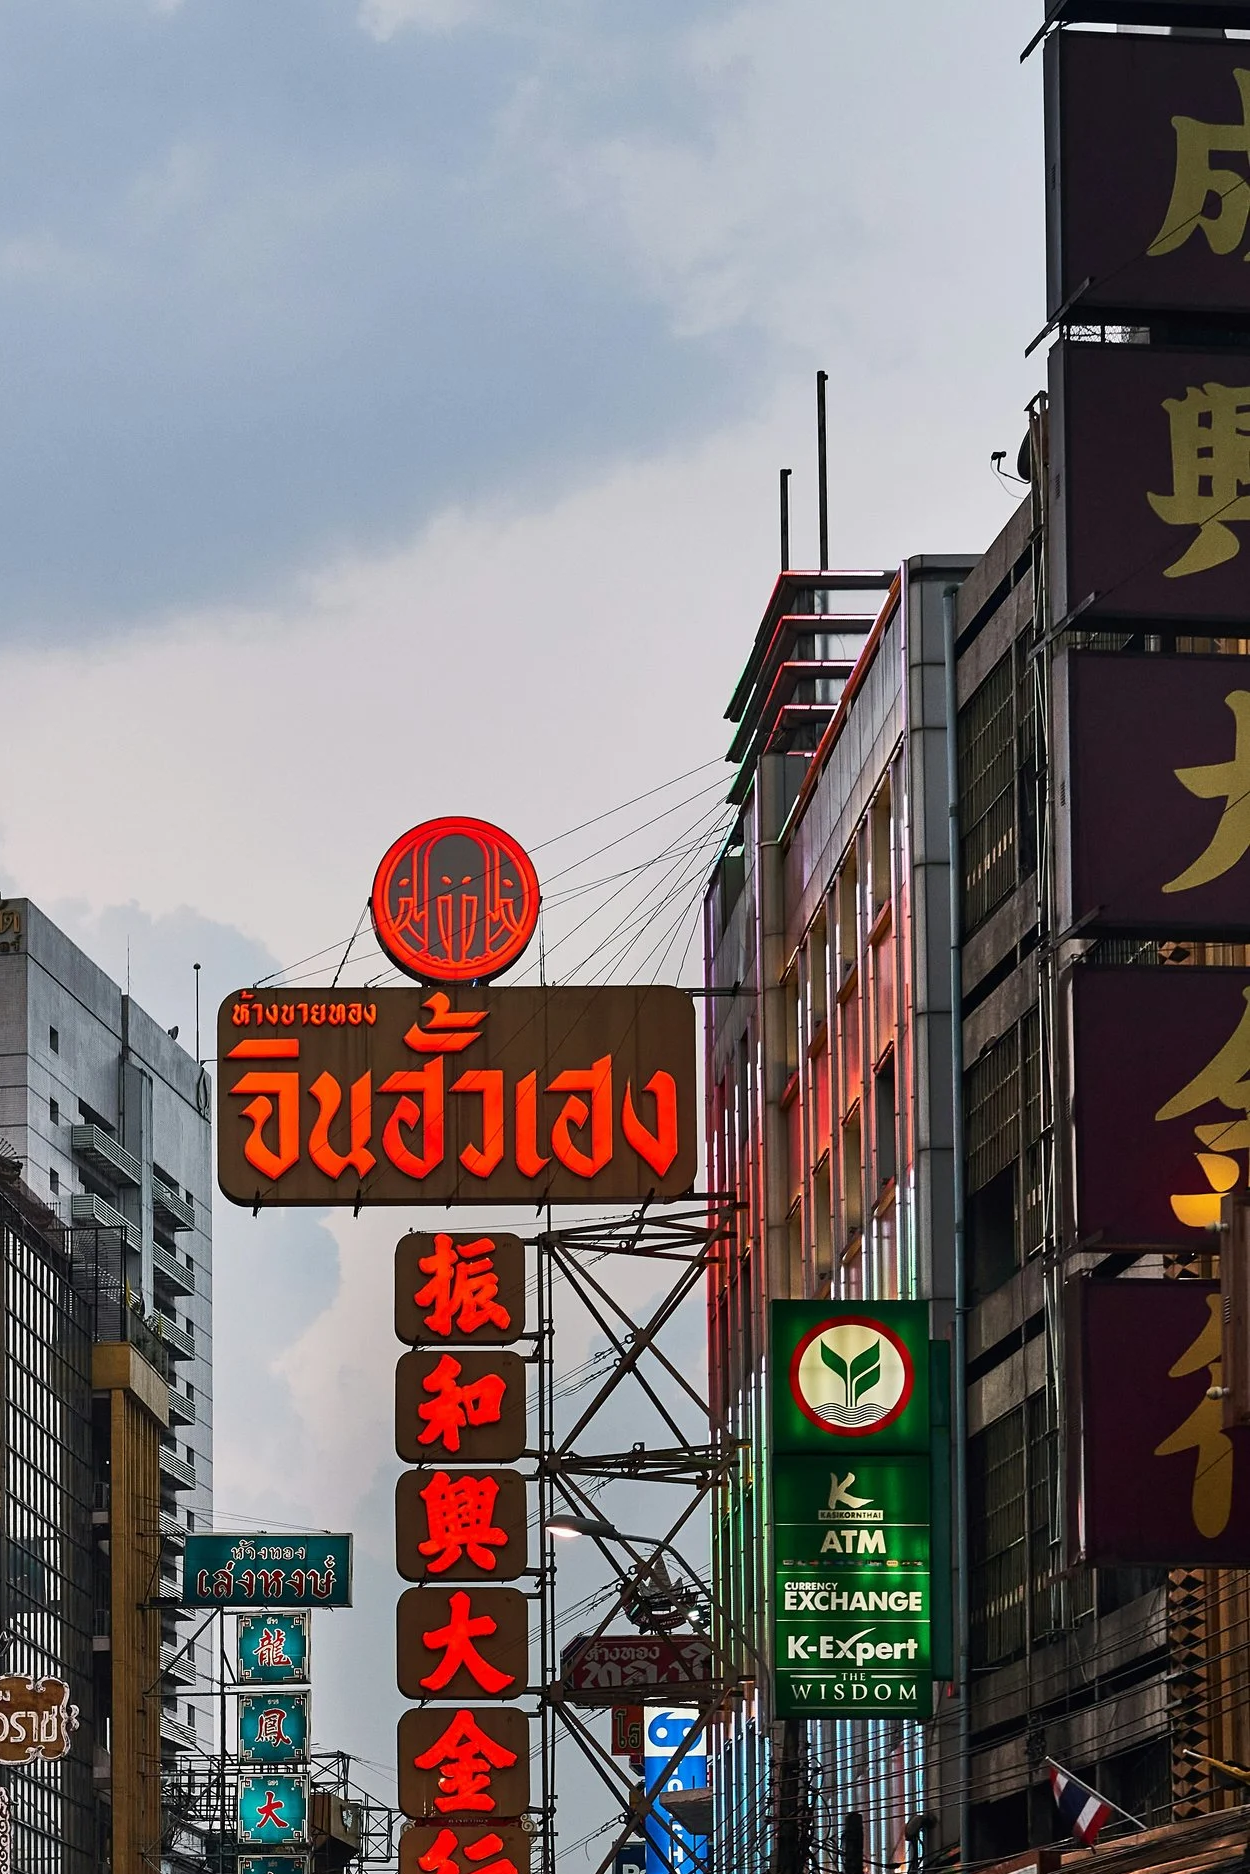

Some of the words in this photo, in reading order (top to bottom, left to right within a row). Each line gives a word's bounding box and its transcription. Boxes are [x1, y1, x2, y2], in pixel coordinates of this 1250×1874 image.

[232, 990, 377, 1028] ห้างขายทอง
[226, 991, 680, 1183] จินฮั้วเฮง
[820, 1511, 882, 1519] KASIKORNTHAI
[231, 1539, 305, 1560] ห้างทอง
[820, 1529, 887, 1554] ATM
[197, 1555, 337, 1599] เล่งหงษ์
[784, 1581, 838, 1591] CURRENCY
[784, 1591, 922, 1612] EXCHANGE
[788, 1627, 918, 1667] K-Expert
[841, 1672, 866, 1681] THE
[791, 1683, 917, 1701] WISDOM
